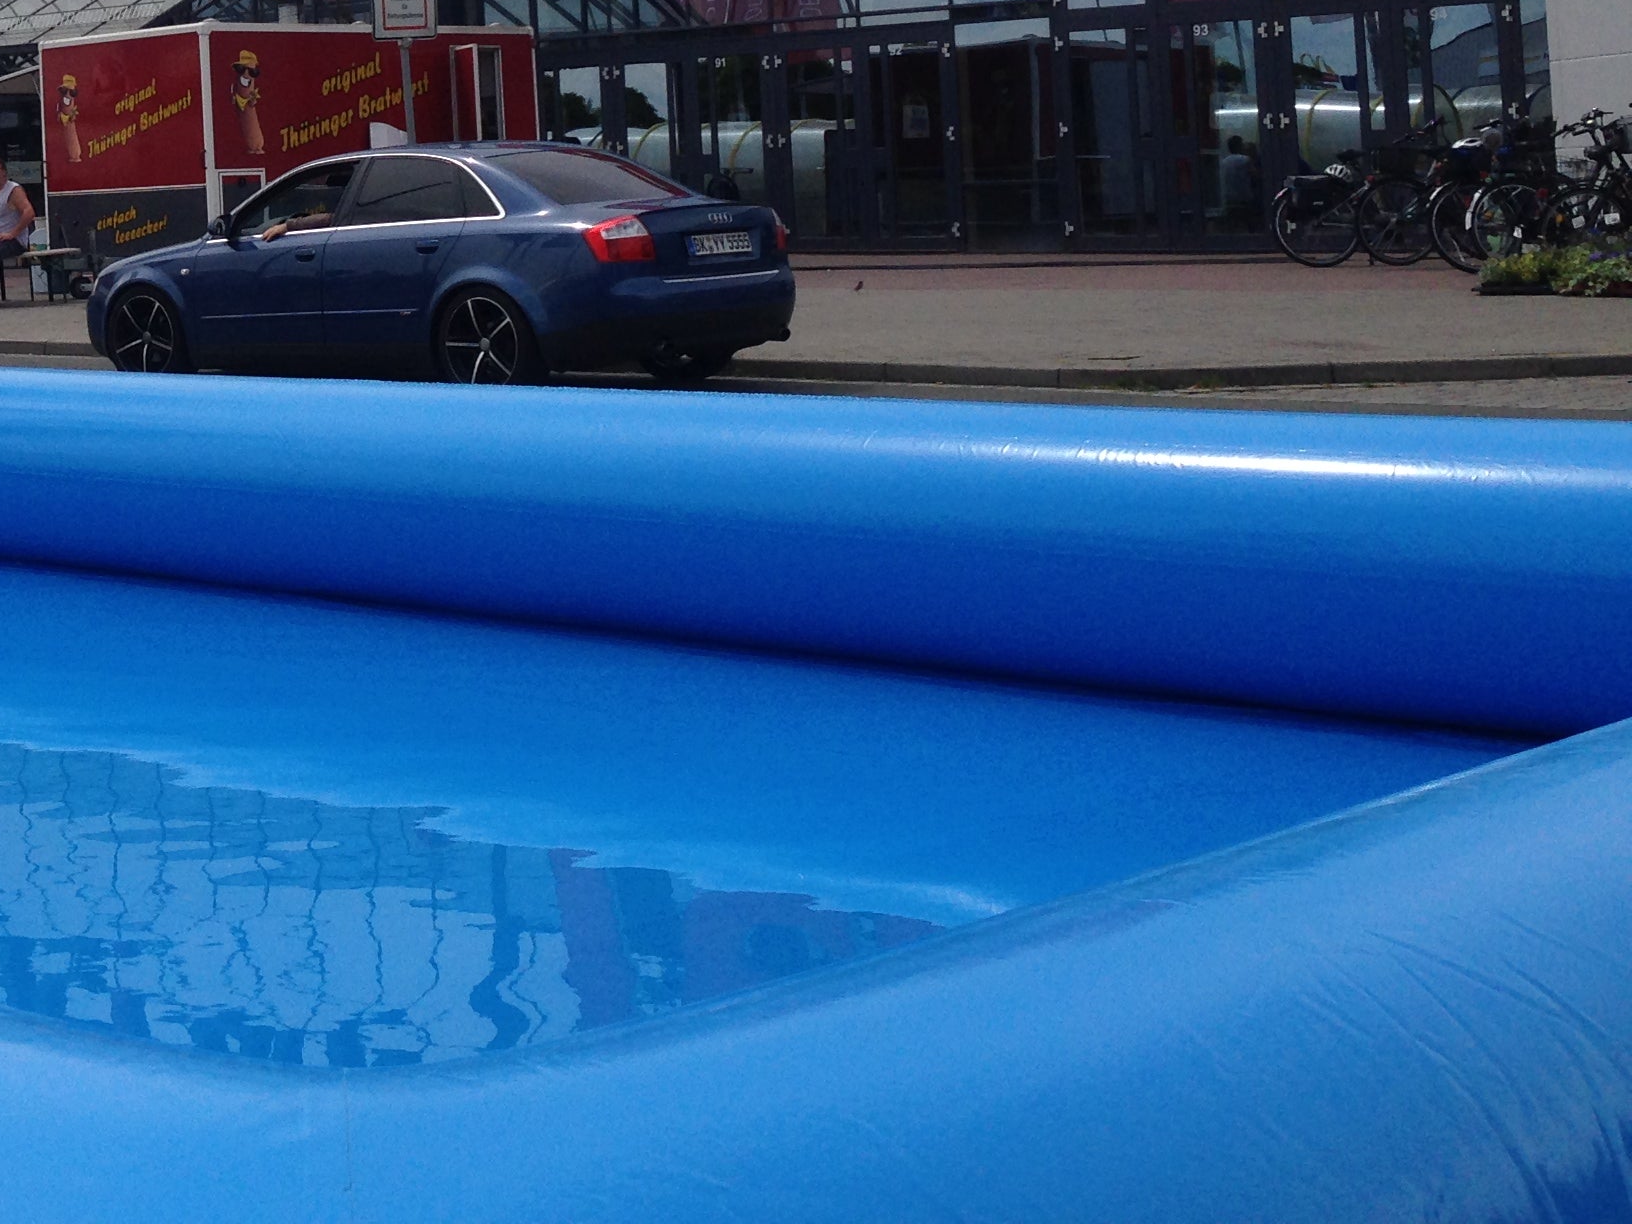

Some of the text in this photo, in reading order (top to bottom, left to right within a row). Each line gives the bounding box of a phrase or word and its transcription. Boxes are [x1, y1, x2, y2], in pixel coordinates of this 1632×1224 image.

[1192, 24, 1209, 36] 93
[321, 52, 382, 97] original
[714, 57, 726, 68] 91
[114, 78, 157, 116] original
[279, 71, 430, 152] Thüringer Bratwrst
[87, 89, 192, 159] Thüringer Bratwurst
[97, 206, 137, 232] einfach
